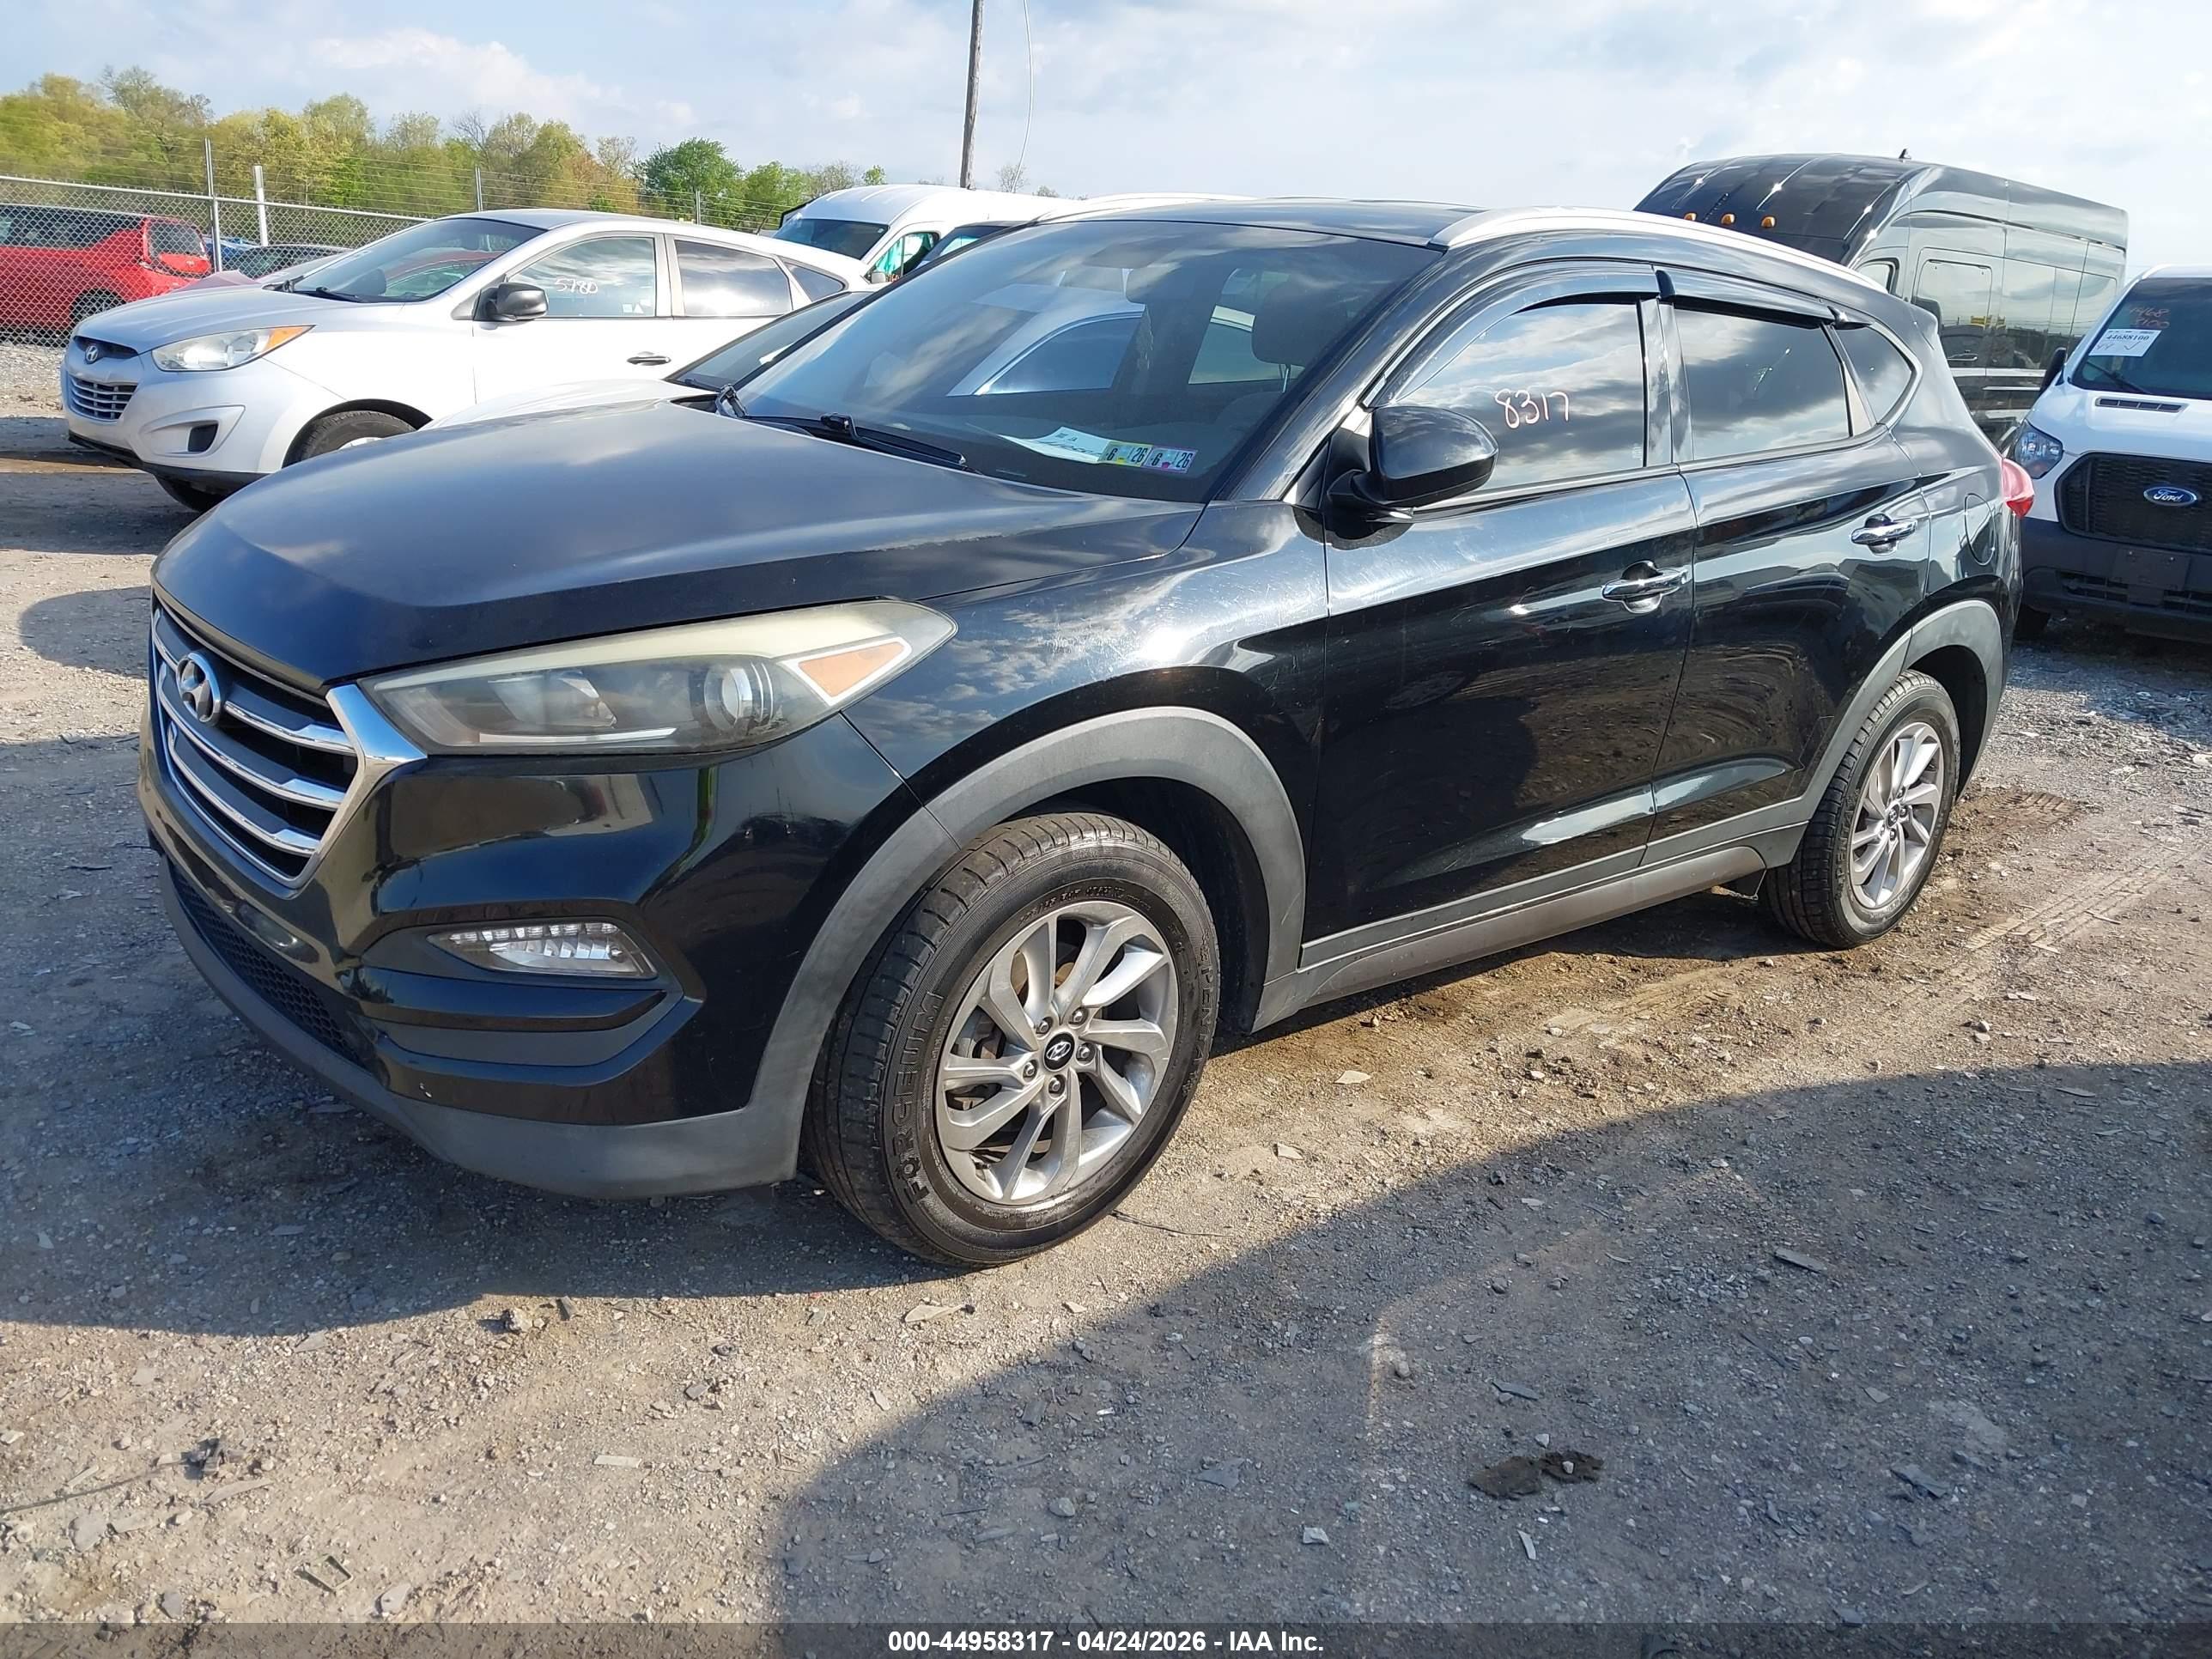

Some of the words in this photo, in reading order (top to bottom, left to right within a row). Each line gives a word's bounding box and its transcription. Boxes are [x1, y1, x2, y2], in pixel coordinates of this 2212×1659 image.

[554, 277, 599, 295] 5780
[1494, 387, 1570, 429] 8317
[1130, 447, 1148, 463] 26
[1176, 452, 1194, 469] 26
[2153, 489, 2185, 502] Ford
[892, 991, 945, 1204] FORCEUM
